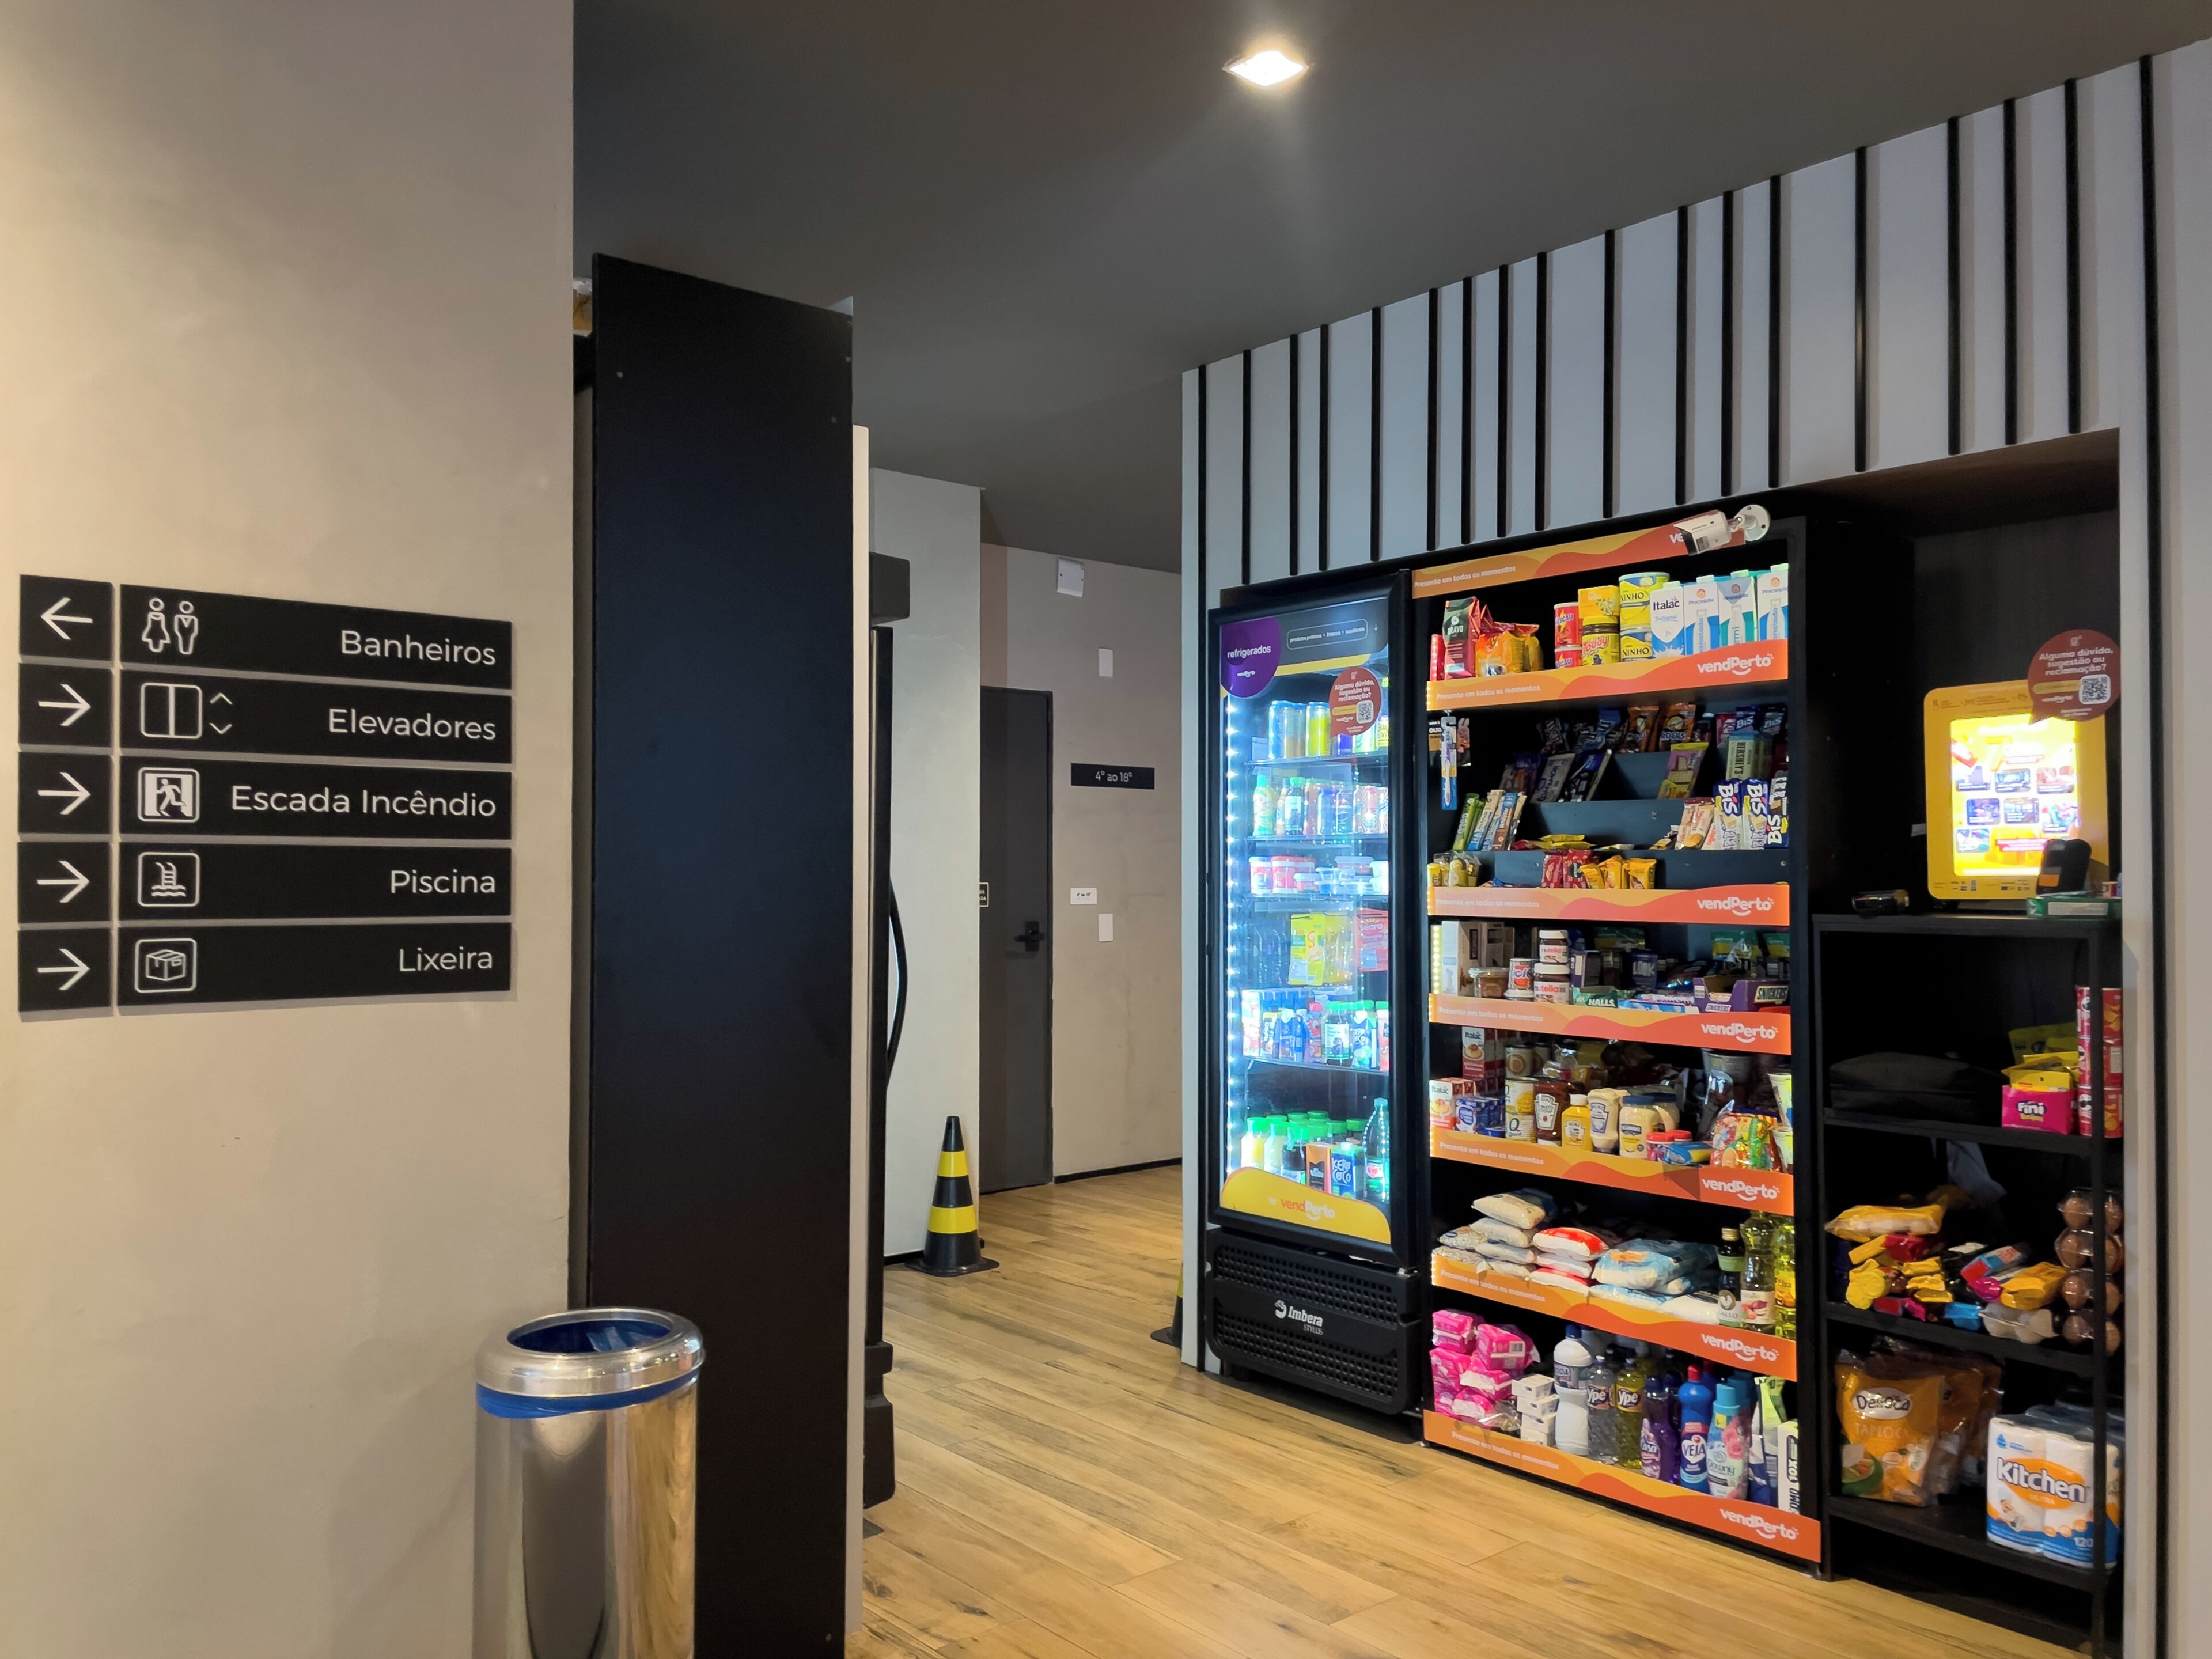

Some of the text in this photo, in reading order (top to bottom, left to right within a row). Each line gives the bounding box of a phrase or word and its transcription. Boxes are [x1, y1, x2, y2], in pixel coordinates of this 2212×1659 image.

[1653, 600, 1680, 611] Italac
[341, 629, 496, 666] Banheiros
[1227, 644, 1271, 660] refrigerados
[2039, 651, 2075, 661] Alguma
[1697, 656, 1772, 675] vendPerto
[2046, 663, 2107, 676] reclamação?
[2047, 657, 2091, 669] sugestão
[1505, 685, 1541, 694] momentos
[329, 707, 497, 741] Elevadores
[1107, 774, 1118, 782] ao
[231, 784, 497, 817] Escada Incêndio
[390, 869, 495, 895] Piscina
[1697, 896, 1772, 912] vendPerto
[399, 947, 493, 973] Lixeira
[1588, 998, 1616, 1007] HALLS
[1701, 1023, 1777, 1039] vendPerto
[2017, 1101, 2045, 1115] Fini
[1702, 1178, 1778, 1199] vendPerto
[1281, 1198, 1335, 1218] vendPerto
[1287, 1306, 1323, 1327] Imbera
[1701, 1333, 1778, 1362] vendPerto
[1683, 1443, 1706, 1458] VEJA
[1997, 1456, 2086, 1504] Kitchen
[1720, 1508, 1797, 1540] vendPerto
